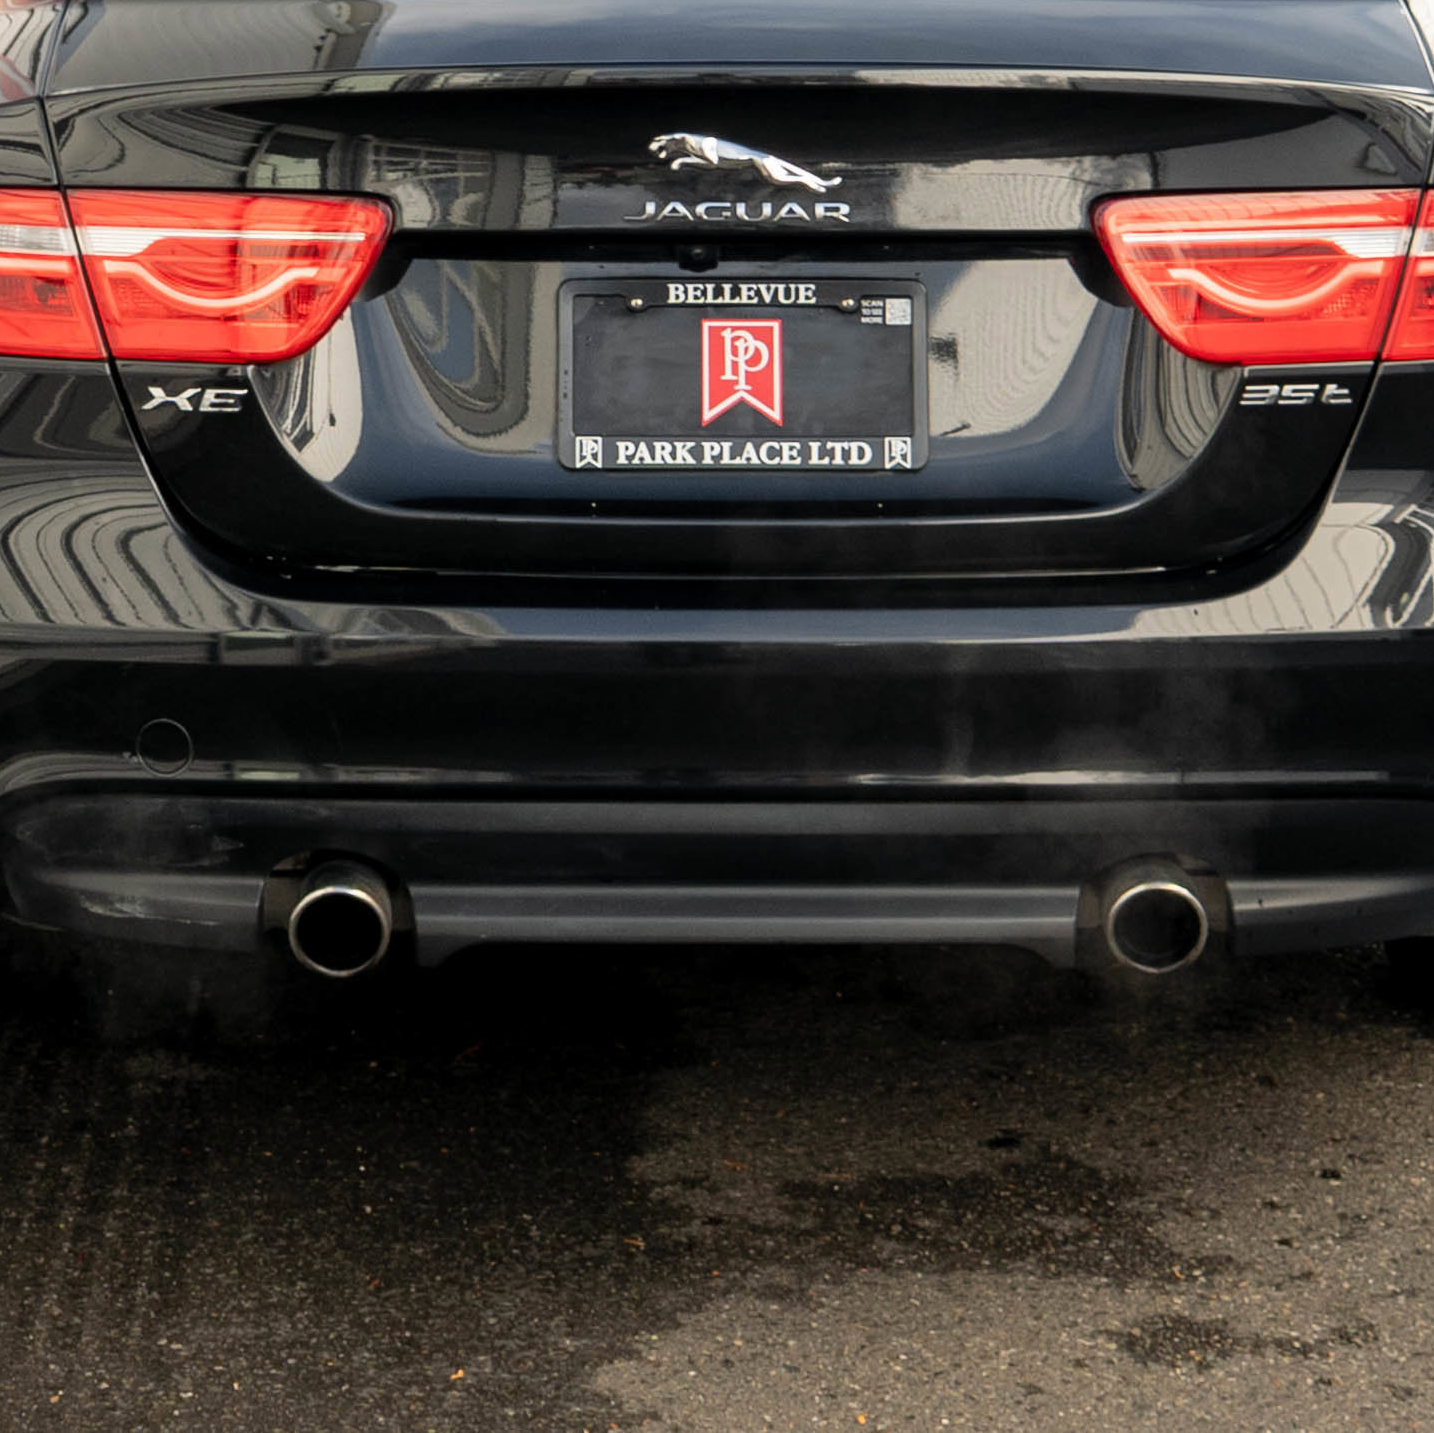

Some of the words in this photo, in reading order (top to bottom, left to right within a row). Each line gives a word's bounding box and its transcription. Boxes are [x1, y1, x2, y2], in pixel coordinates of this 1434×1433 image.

[623, 200, 851, 223] JAGUAR
[667, 283, 817, 305] BELLEVUE
[140, 385, 249, 413] XE
[616, 441, 696, 465] PARK
[701, 441, 802, 465] PLACE
[808, 441, 873, 465] LTD
